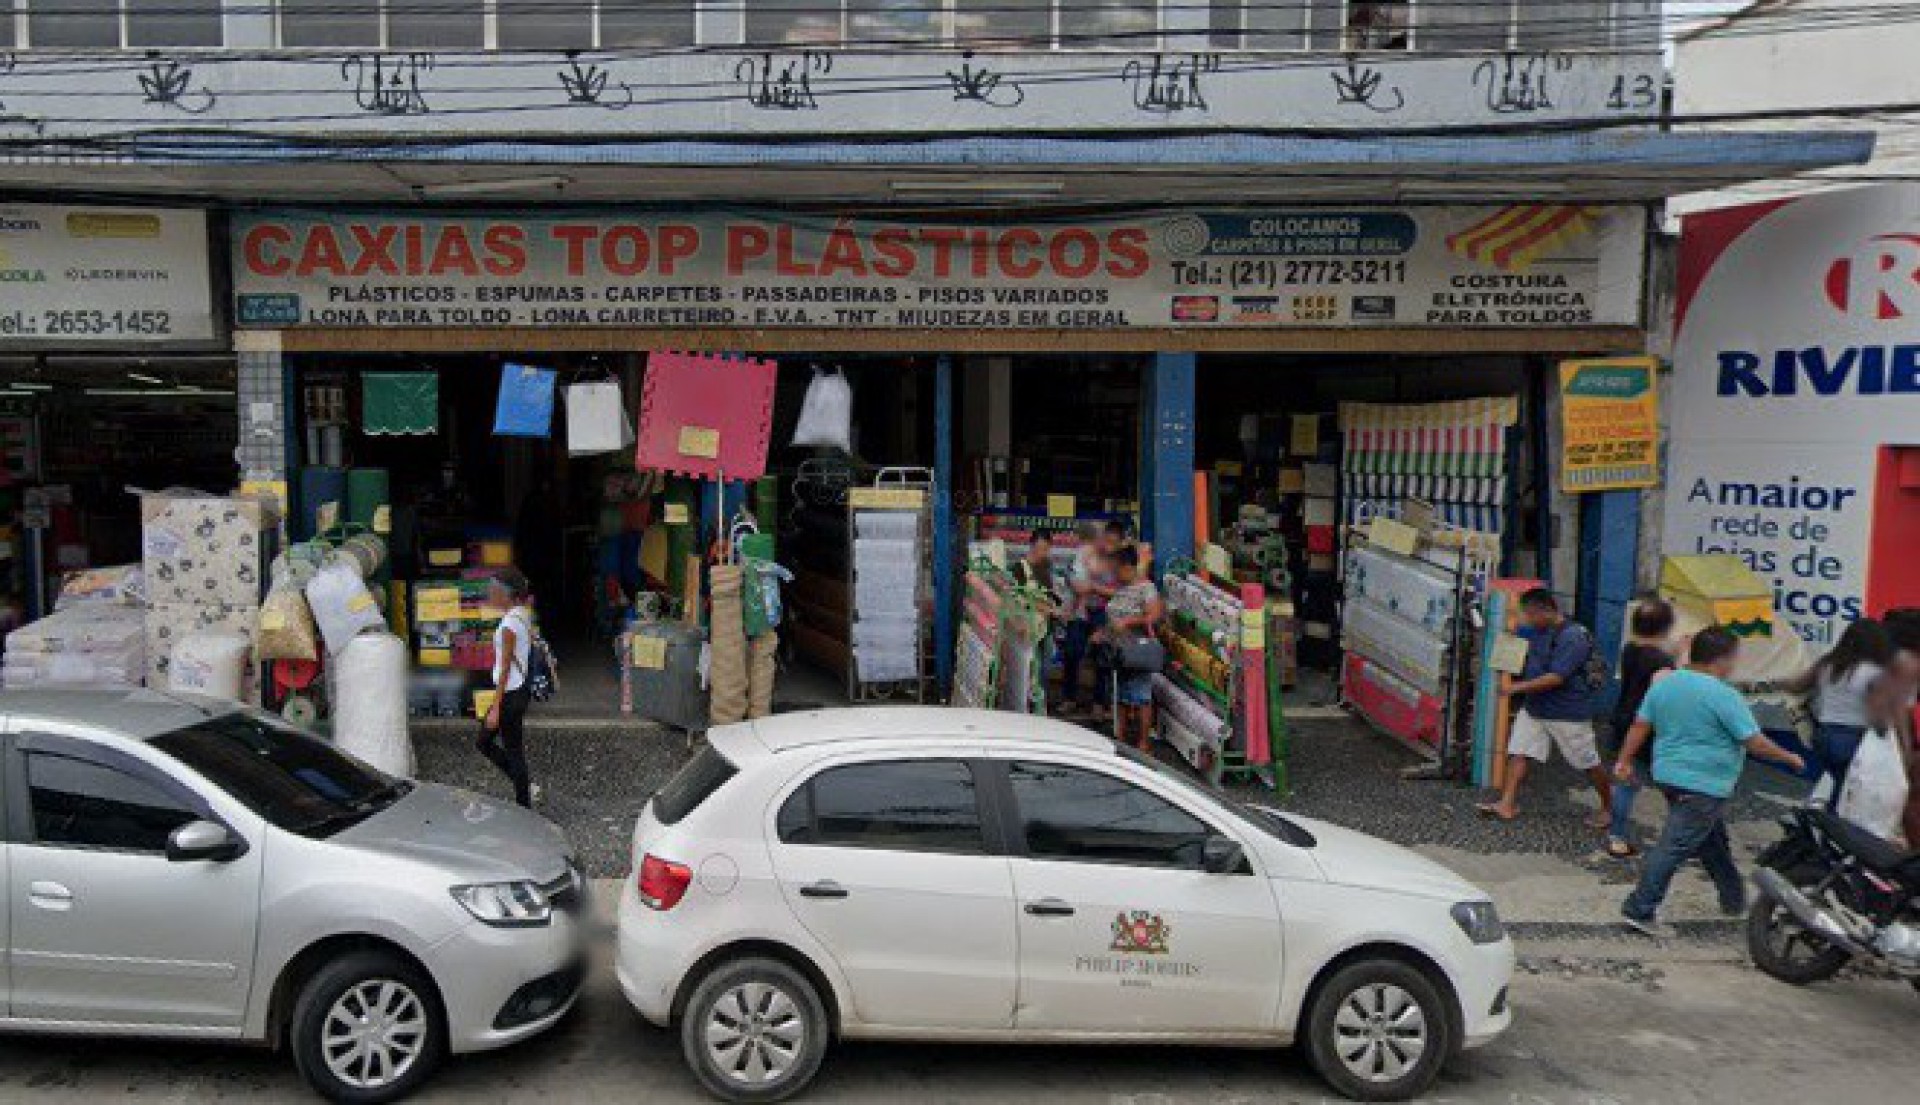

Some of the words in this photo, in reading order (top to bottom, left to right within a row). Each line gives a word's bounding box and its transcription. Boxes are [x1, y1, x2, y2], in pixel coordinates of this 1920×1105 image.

[1251, 217, 1361, 236] COLOCAMOS
[243, 223, 527, 277] CAXIAS
[551, 224, 698, 277] TOP
[726, 214, 1151, 279] PLÁSTICOS
[1170, 260, 1222, 285] Tel.:
[1229, 260, 1277, 290] (21)
[1284, 260, 1406, 285] 2772-5211
[1451, 274, 1568, 288] COSTURA
[328, 284, 456, 302] PLÁSTICOS
[475, 286, 585, 302] ESPUMAS
[604, 286, 723, 302] CARPETES
[741, 286, 897, 303] PASSADEIRAS
[918, 287, 985, 304] PISOS
[993, 288, 1110, 305] VARIADOS
[1432, 289, 1585, 306] ELETRÔNICA
[1, 309, 36, 334] el.:
[45, 309, 172, 335] 2653-1452
[309, 308, 369, 324] LONA
[376, 308, 432, 324] PARA
[439, 308, 512, 324] TOLDO
[532, 308, 590, 324] LONA
[596, 307, 736, 324] CARRETEIRO
[755, 308, 813, 324] E.V.A.
[834, 308, 878, 324] TNT
[898, 309, 1011, 326] MIUDEZAS
[1017, 310, 1049, 326] EM
[1055, 309, 1130, 326] GERAL
[1426, 309, 1489, 323] PARA
[1496, 309, 1593, 323] TOLDOS
[1687, 477, 1712, 503] A
[1719, 475, 1857, 511] maior
[1710, 513, 1779, 538] rede
[1789, 515, 1829, 542] de
[1792, 545, 1844, 581] de
